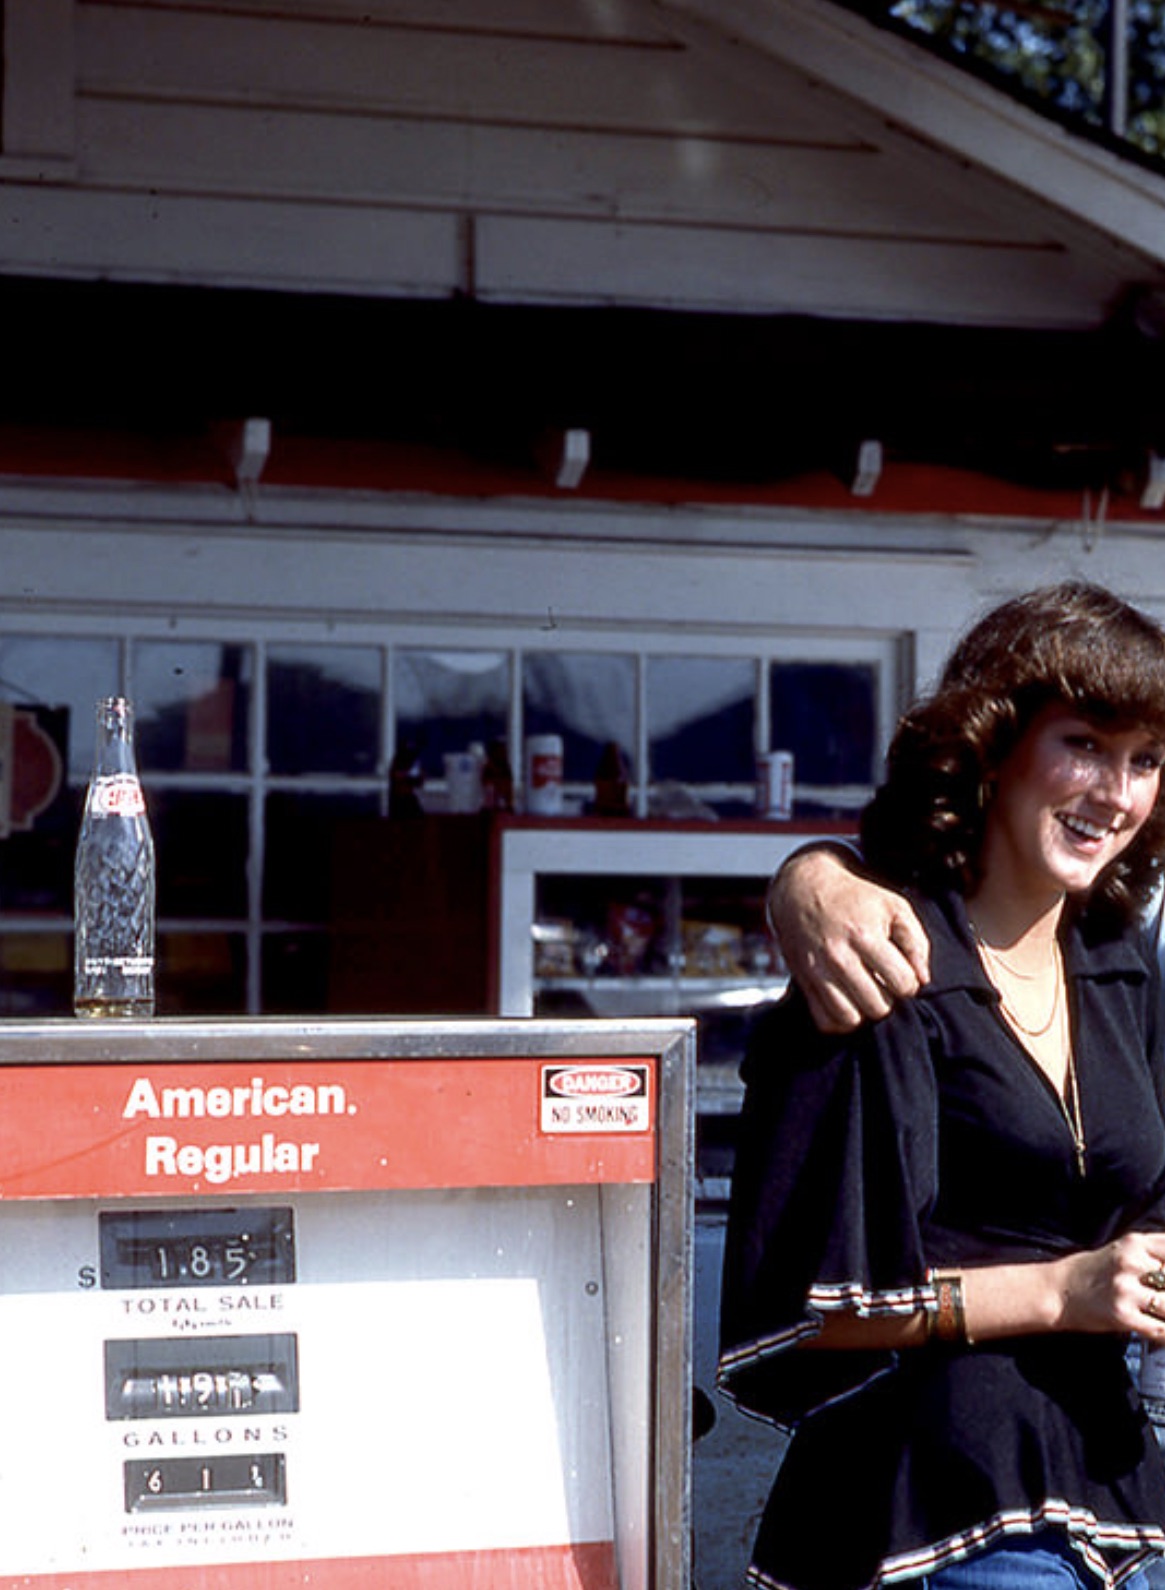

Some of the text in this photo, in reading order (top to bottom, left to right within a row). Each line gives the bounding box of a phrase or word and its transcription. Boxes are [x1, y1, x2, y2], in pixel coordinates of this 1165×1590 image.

[563, 1073, 633, 1093] DANGER
[551, 1104, 639, 1124] NO SMOKING
[145, 1133, 320, 1184] Regular
[121, 1293, 284, 1315] TOTAL SALE
[123, 1426, 288, 1447] GALLONS
